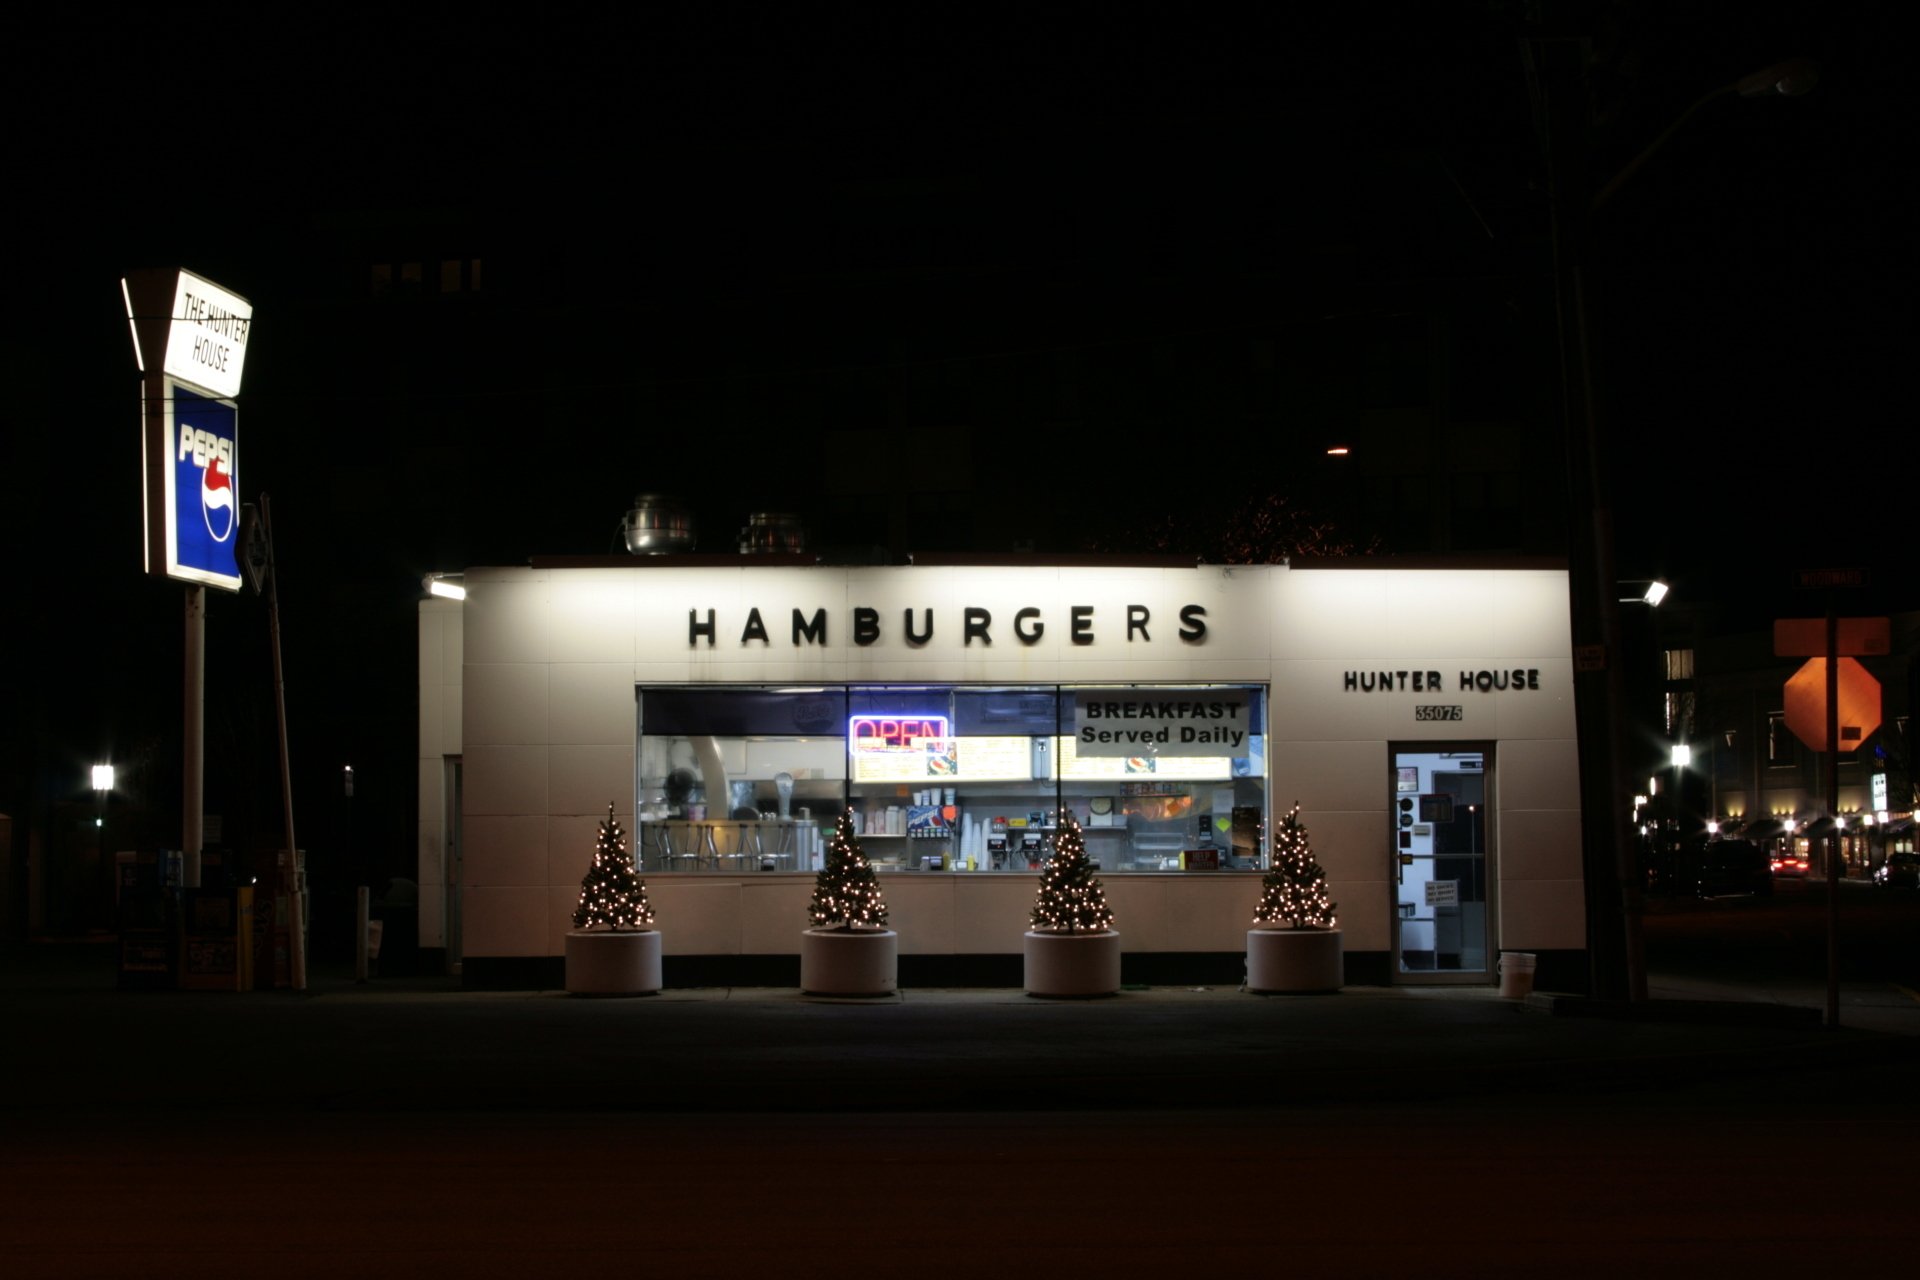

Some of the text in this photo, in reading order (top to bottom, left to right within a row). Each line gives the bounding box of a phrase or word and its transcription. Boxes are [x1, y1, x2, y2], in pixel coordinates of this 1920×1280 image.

[184, 292, 249, 346] THE HUNTER
[192, 334, 230, 374] HOUSE
[178, 423, 234, 477] PEPSI
[1800, 570, 1862, 586] WOODWARD
[688, 603, 1208, 646] HAMBURGERS
[1344, 668, 1540, 693] HUNTER HOUSE
[1086, 701, 1241, 719] BREAKFAST
[1416, 706, 1462, 720] 35075
[854, 719, 945, 752] OPEN
[1081, 726, 1244, 748] Served Daily
